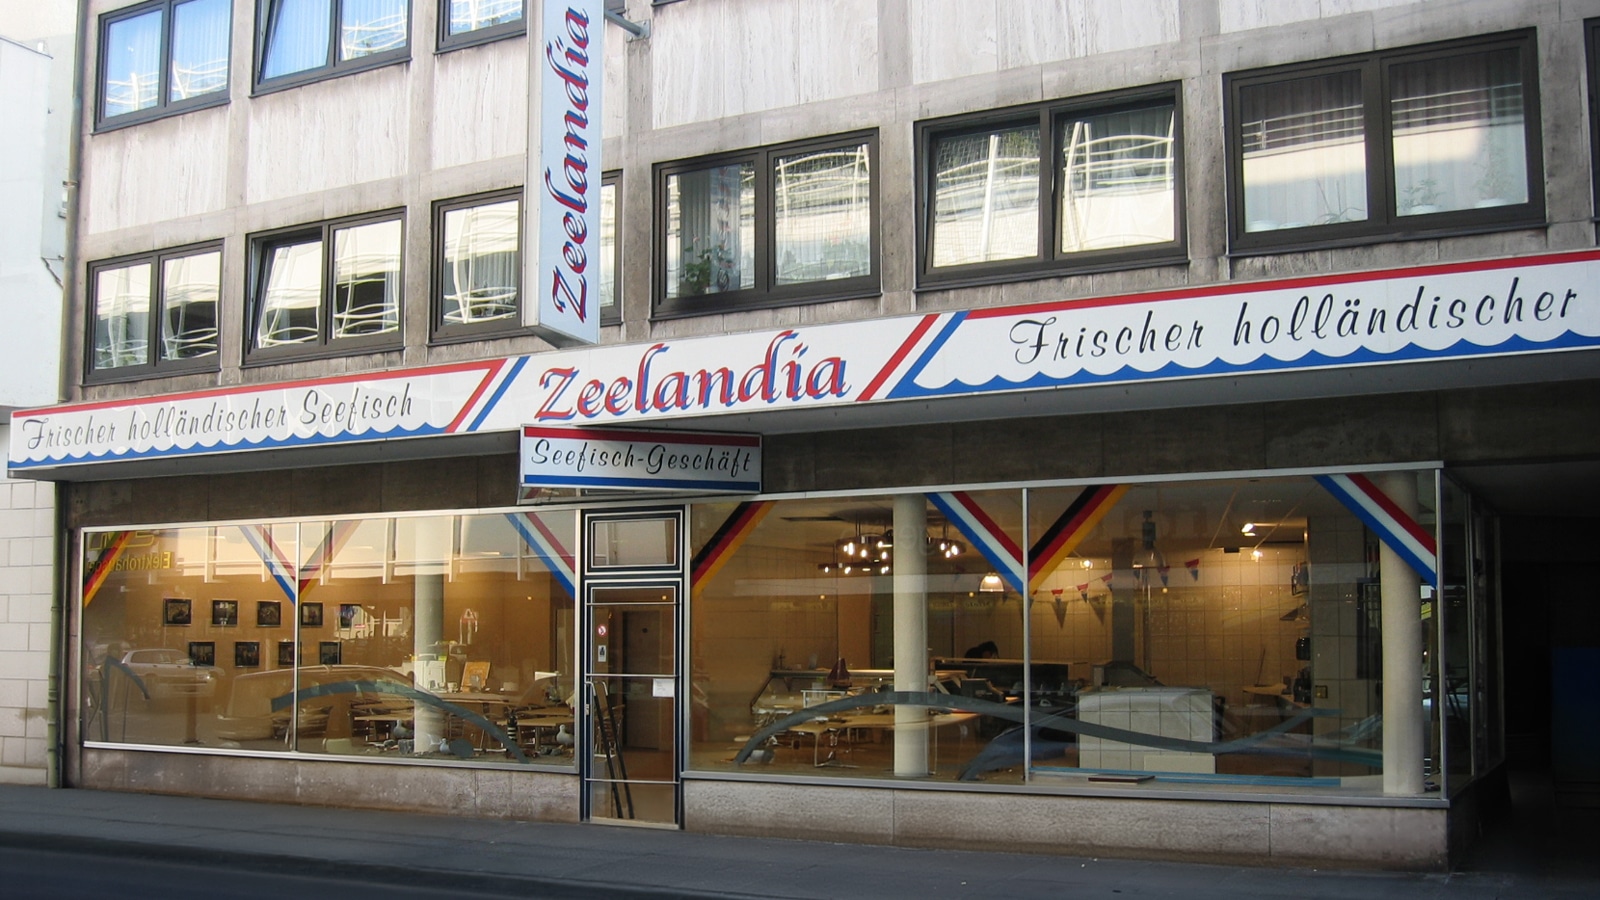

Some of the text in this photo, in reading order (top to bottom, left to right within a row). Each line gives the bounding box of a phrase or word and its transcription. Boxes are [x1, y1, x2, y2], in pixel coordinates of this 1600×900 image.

[545, 6, 590, 323] Zeelandia
[1009, 277, 1578, 365] Frischer holländischer
[22, 382, 412, 450] Frischer holländischer Seefisch
[534, 330, 852, 422] Zeelandia
[531, 438, 751, 478] Seefisch-Geschäft
